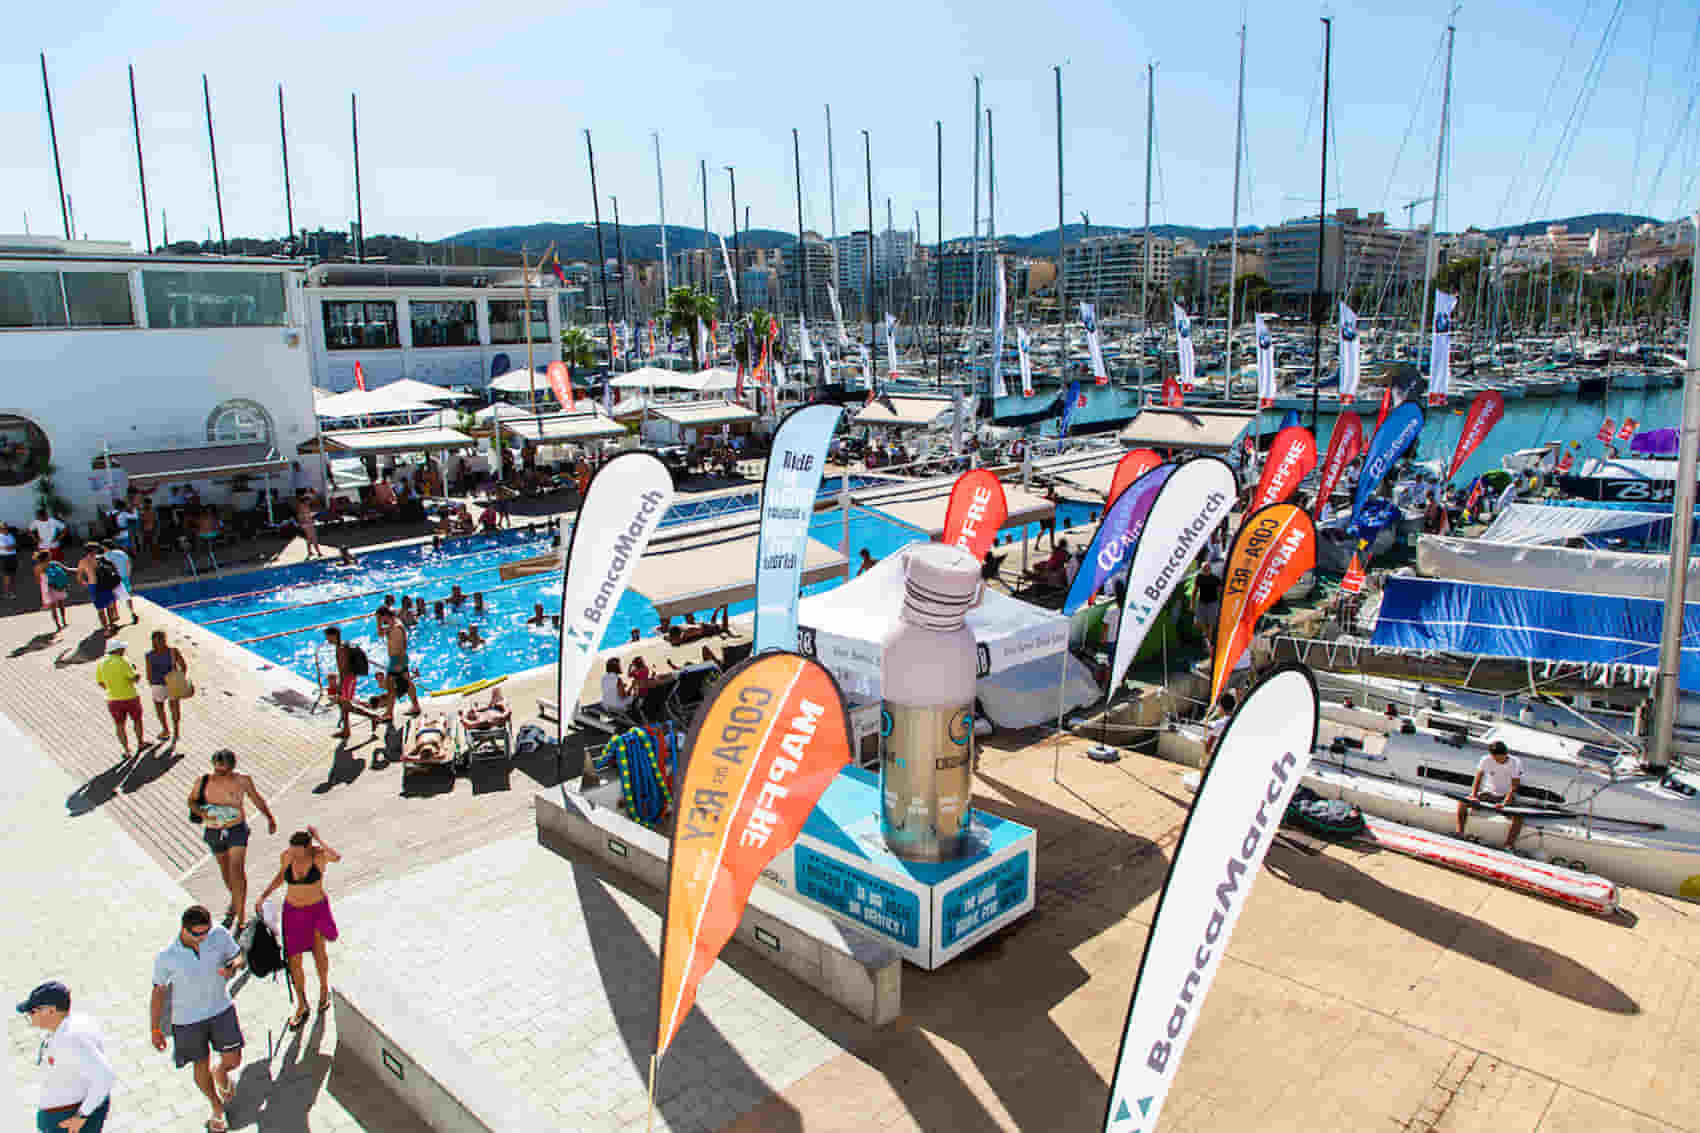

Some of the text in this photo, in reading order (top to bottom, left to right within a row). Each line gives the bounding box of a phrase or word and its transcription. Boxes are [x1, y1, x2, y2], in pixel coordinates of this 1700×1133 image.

[584, 487, 665, 624] BancaMarch
[1144, 492, 1226, 601] BancaMarch
[1145, 750, 1298, 1076] BancaMarch
